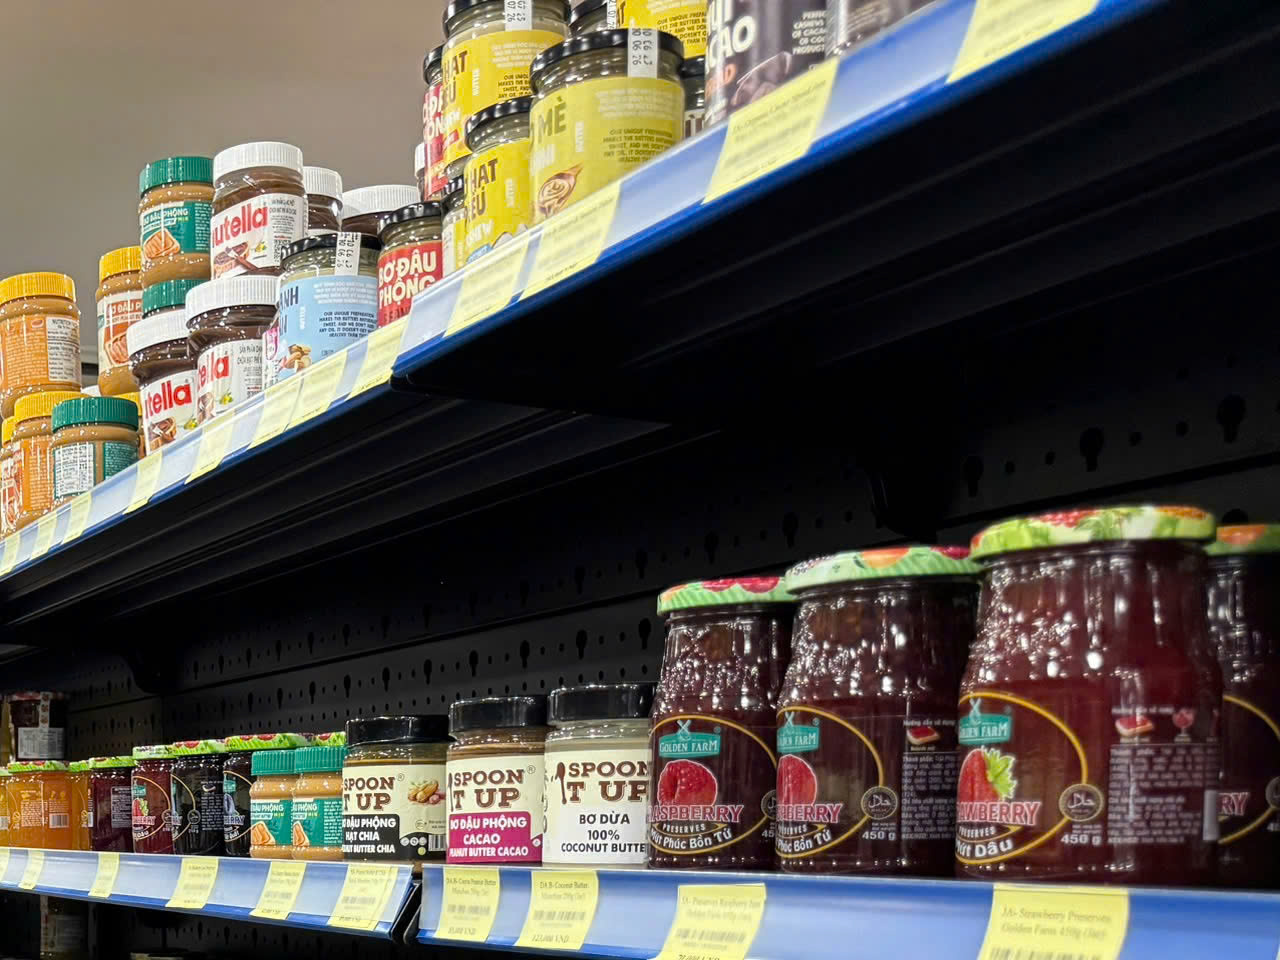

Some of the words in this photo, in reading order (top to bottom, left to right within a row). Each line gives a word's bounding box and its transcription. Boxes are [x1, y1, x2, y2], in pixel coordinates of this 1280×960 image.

[660, 742, 688, 753] GOLDEN
[691, 740, 718, 752] FARM
[343, 776, 396, 791] SPOON
[454, 769, 525, 787] SPOON
[356, 792, 391, 811] UP
[474, 787, 520, 809] UP
[361, 815, 397, 831] PHỘNG
[482, 814, 528, 831] PHỘNG
[579, 813, 597, 825] BƠ
[599, 810, 631, 825] DỪA
[662, 823, 706, 834] PRESERVES
[358, 831, 380, 841] CHIA
[463, 833, 501, 845] CACAO
[587, 829, 620, 841] 100%
[861, 830, 886, 841] 450
[1060, 833, 1089, 845] 450
[376, 844, 396, 854] CHIA
[497, 846, 529, 857] CACAO
[561, 842, 609, 853] COCONUT
[611, 842, 648, 853] BUTTE
[974, 838, 1014, 857] Dâu
